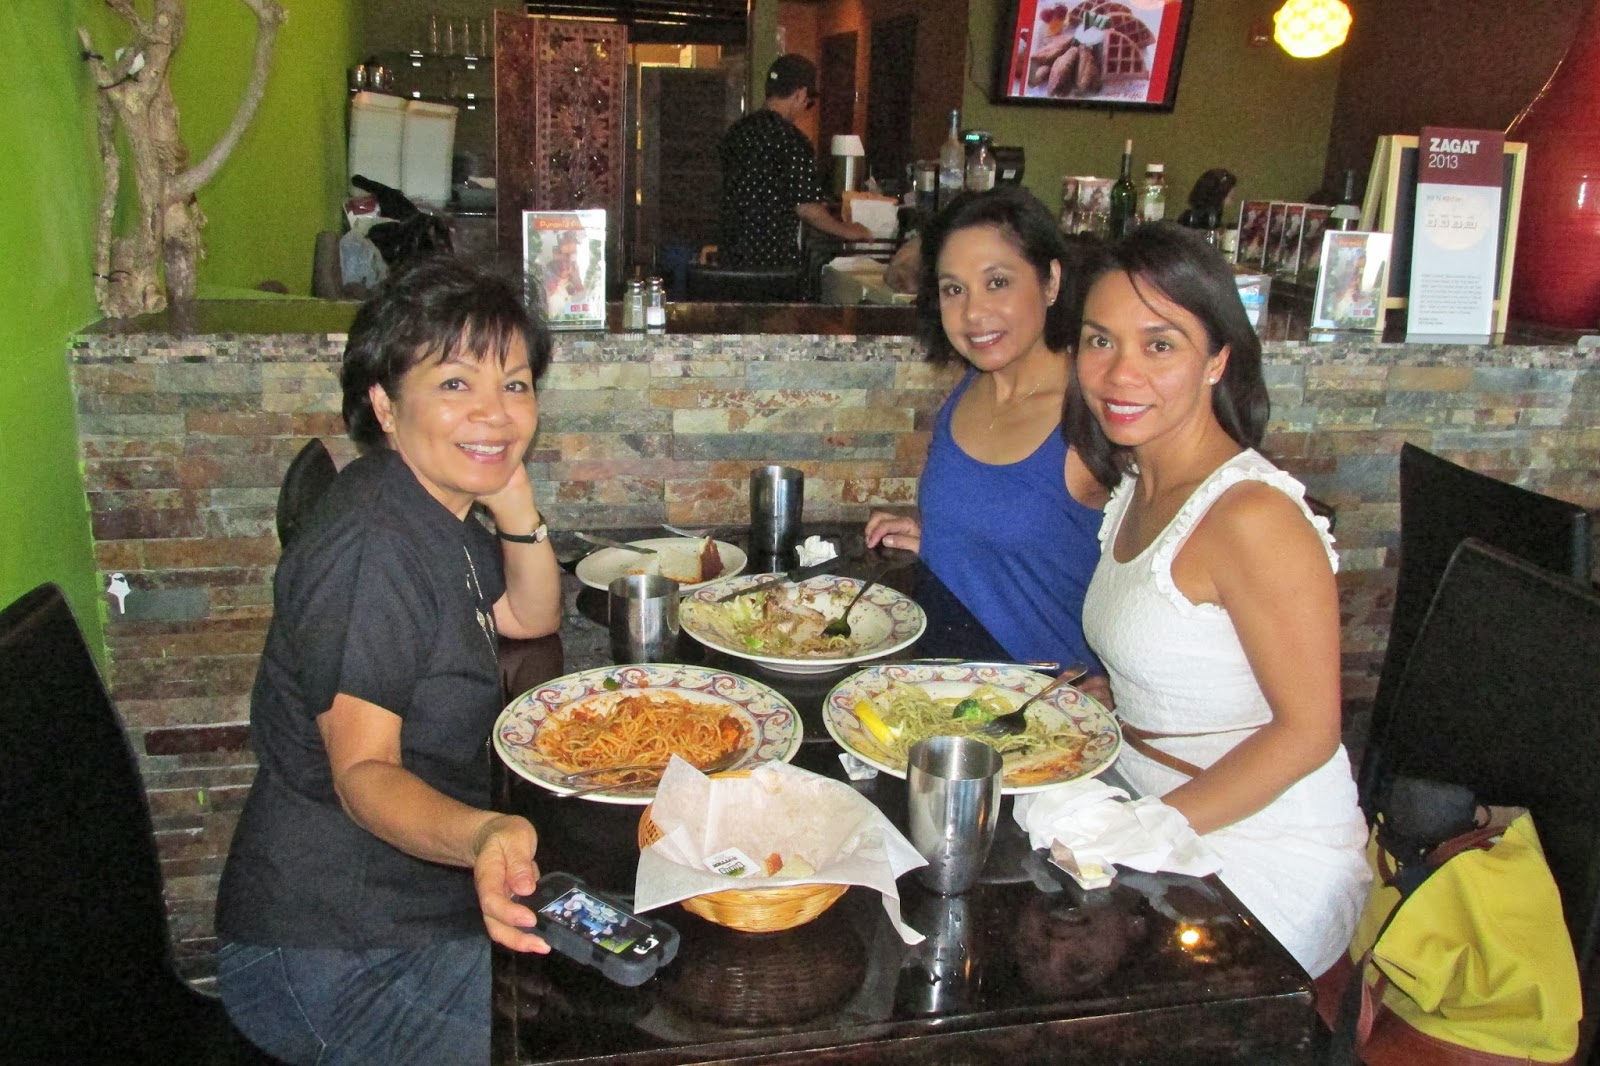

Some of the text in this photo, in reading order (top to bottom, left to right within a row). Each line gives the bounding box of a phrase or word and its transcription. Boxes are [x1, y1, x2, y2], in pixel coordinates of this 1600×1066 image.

[1429, 137, 1480, 155] ZAGAT
[1428, 153, 1459, 169] 2013
[540, 220, 570, 229] Pyramid
